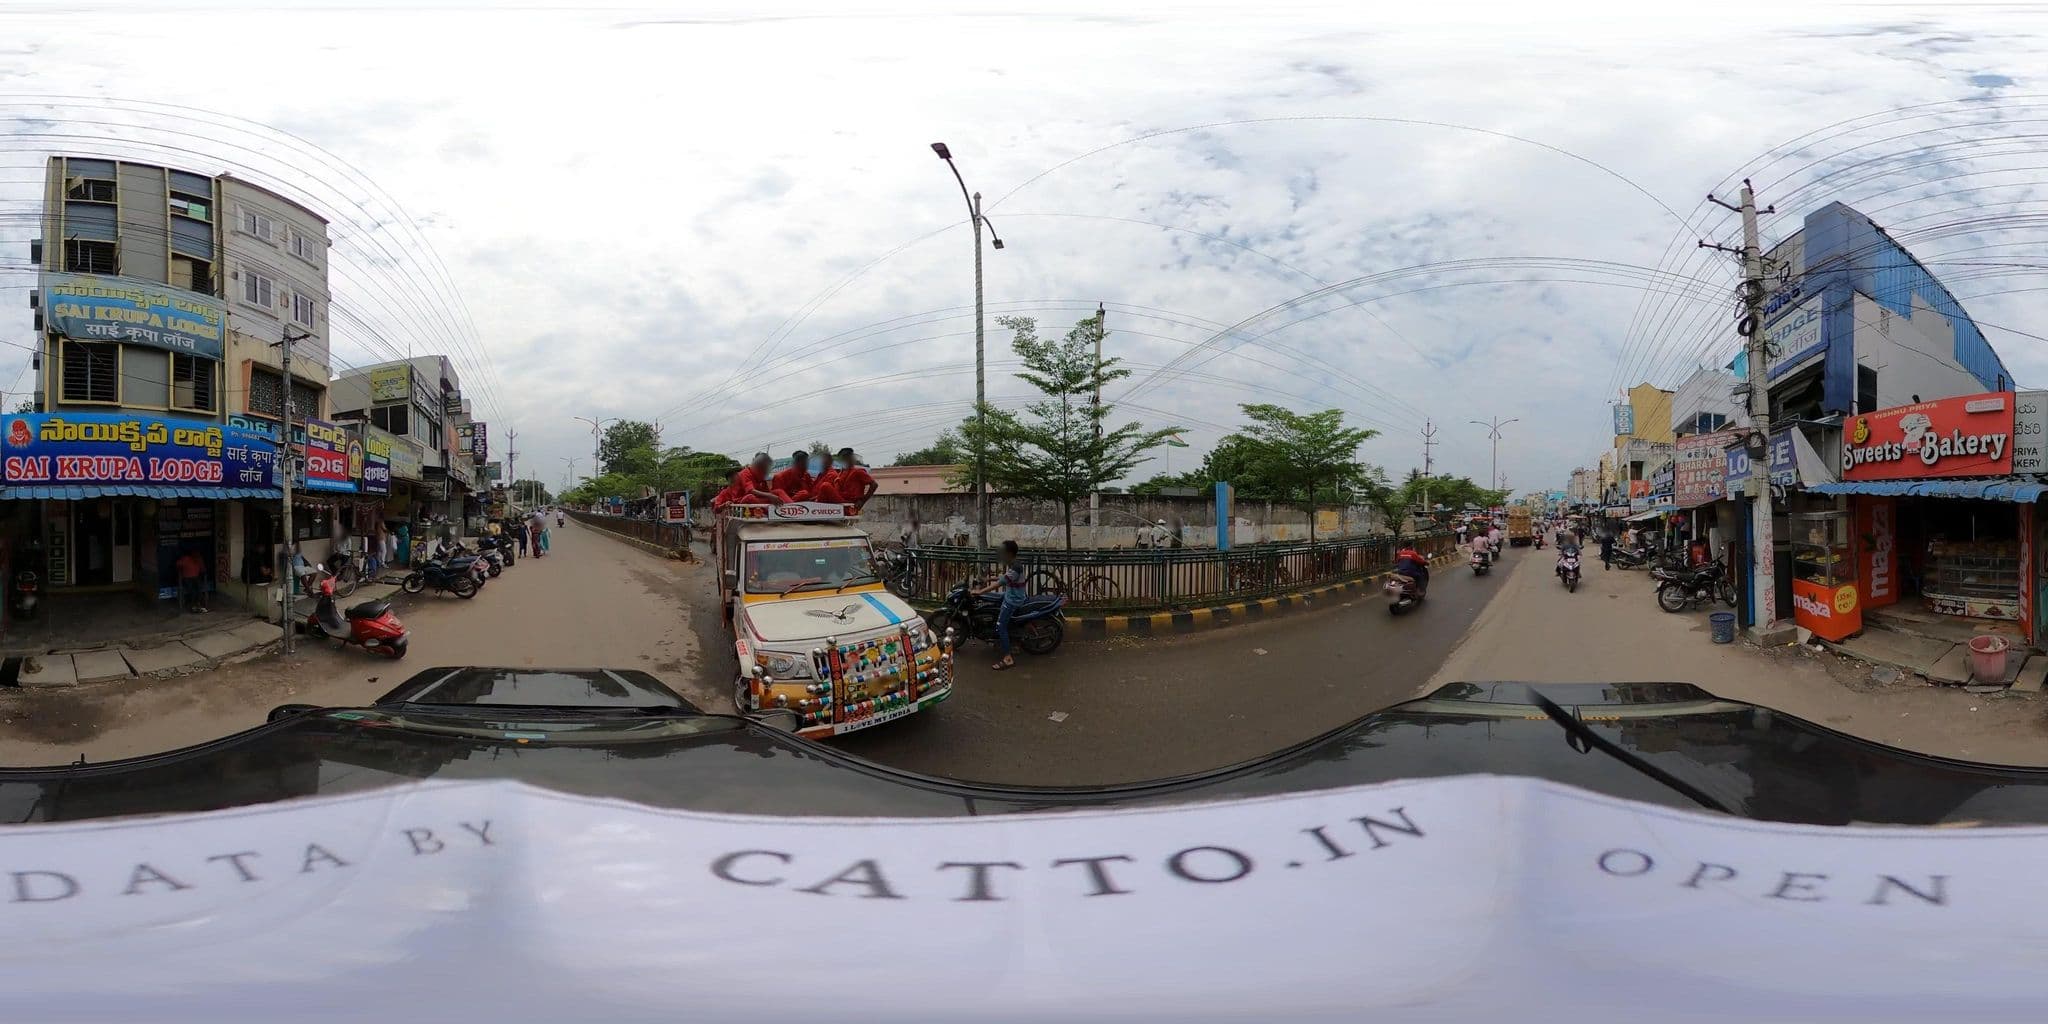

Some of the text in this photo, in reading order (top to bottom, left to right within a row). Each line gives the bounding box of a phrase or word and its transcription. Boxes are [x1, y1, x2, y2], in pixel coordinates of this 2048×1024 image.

[55, 303, 218, 339] SAI KRUPA LODGE
[85, 322, 195, 350] साई कृपा लॉज
[1874, 402, 1937, 419] VISHNU PRIYA
[40, 418, 168, 451] సాయికృప
[227, 444, 273, 467] साई कृपा
[367, 437, 391, 458] LODGE
[1844, 428, 2007, 470] Sweets Bakery
[6, 456, 223, 481] SAI KRUPA LODGE
[240, 465, 263, 483] लॉज
[2014, 459, 2041, 468] AKERY
[1793, 594, 1831, 618] maaza
[874, 716, 888, 724] MY
[888, 708, 912, 719] INDIA
[8, 819, 496, 901] DATA BY
[709, 806, 1427, 901] CATTO.IN
[1596, 848, 1952, 906] OPEN
